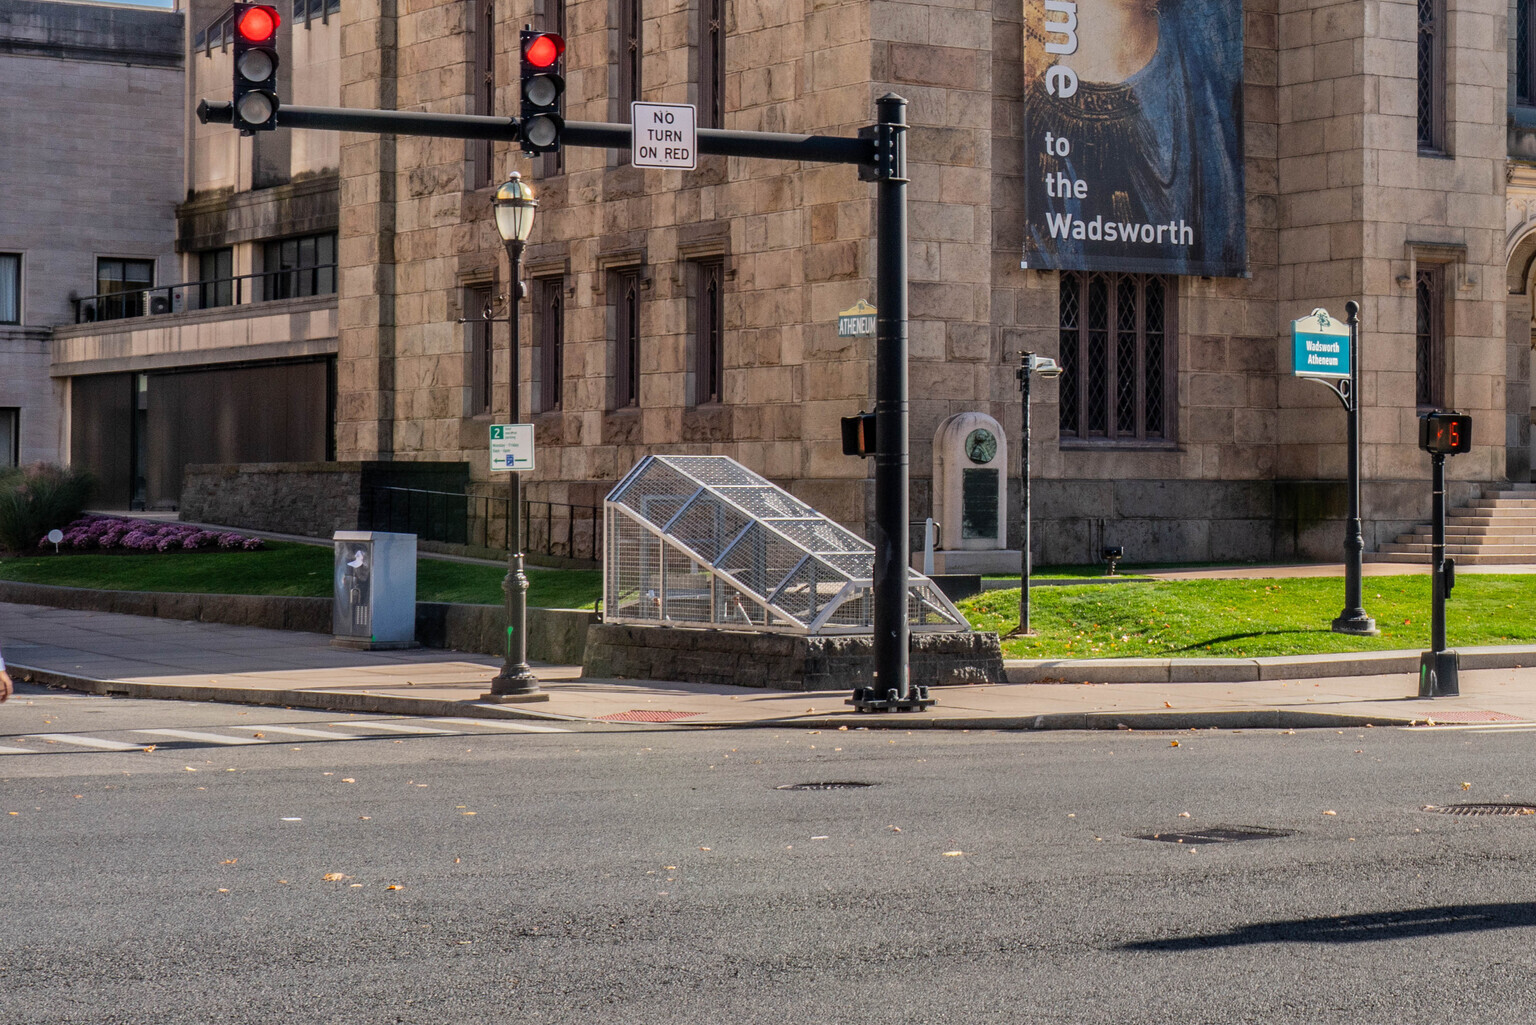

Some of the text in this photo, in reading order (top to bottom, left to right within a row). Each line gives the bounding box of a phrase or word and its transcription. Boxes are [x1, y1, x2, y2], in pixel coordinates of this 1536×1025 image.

[653, 111, 675, 124] NO
[647, 128, 682, 142] TURN
[1045, 131, 1071, 157] to
[640, 146, 689, 160] ON RED
[1045, 172, 1088, 199] the
[1045, 212, 1194, 246] Wadsworth
[839, 316, 877, 335] ATHENEUM
[1305, 340, 1340, 353] Wadsworth
[1307, 354, 1339, 366] Atheneum
[494, 428, 501, 439] 2
